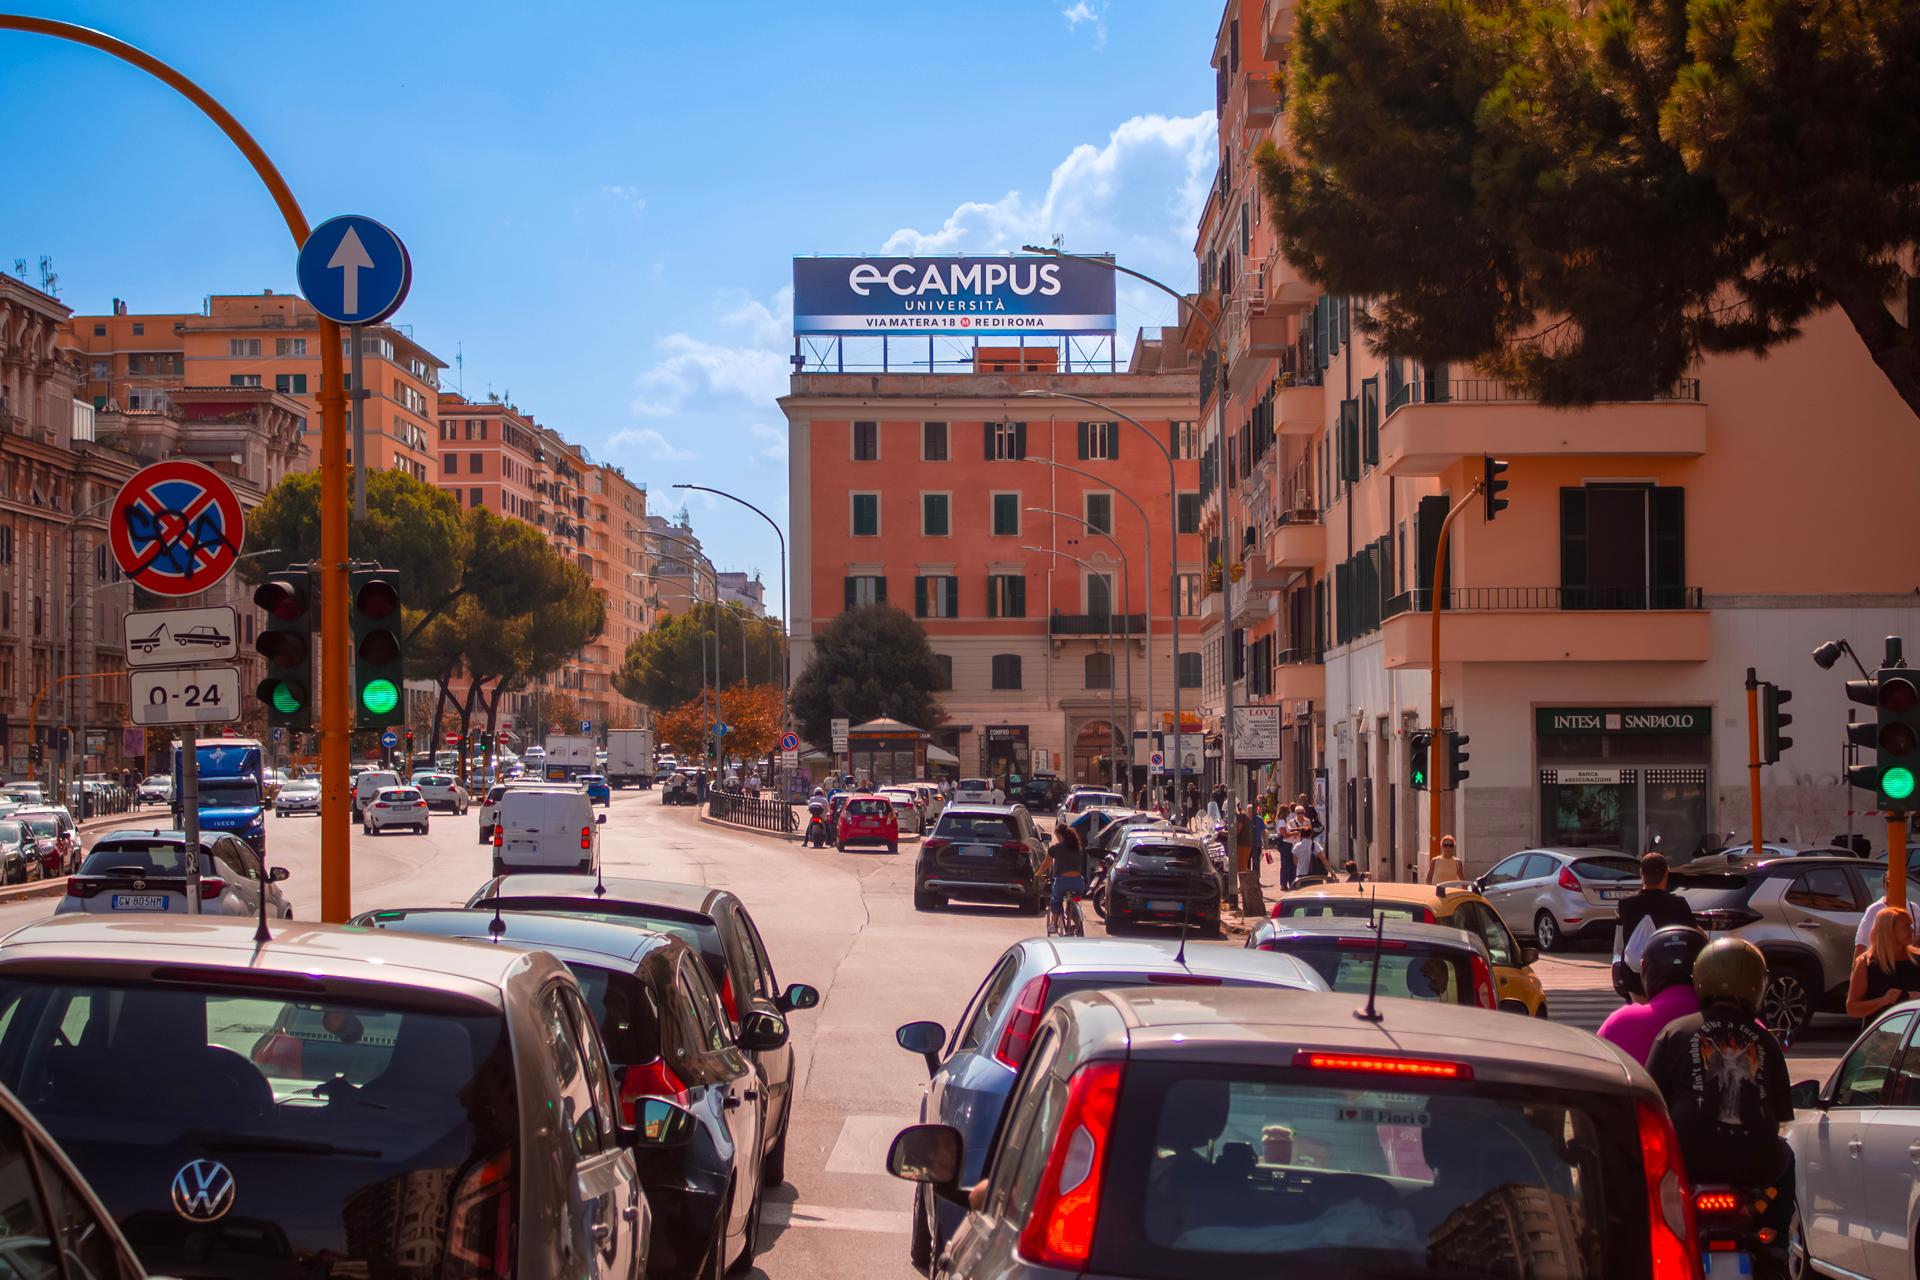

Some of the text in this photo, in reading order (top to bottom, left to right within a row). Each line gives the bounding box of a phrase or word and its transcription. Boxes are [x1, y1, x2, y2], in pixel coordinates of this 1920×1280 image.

[904, 298, 1005, 311] UNIVERSITÀ
[866, 318, 887, 327] VIA
[889, 318, 939, 327] MATERA
[941, 318, 956, 327] 18
[975, 318, 989, 327] RE
[992, 318, 1004, 327] DI
[1007, 318, 1044, 327] ROMA
[1554, 714, 1694, 729] INTESA SANPAOLO
